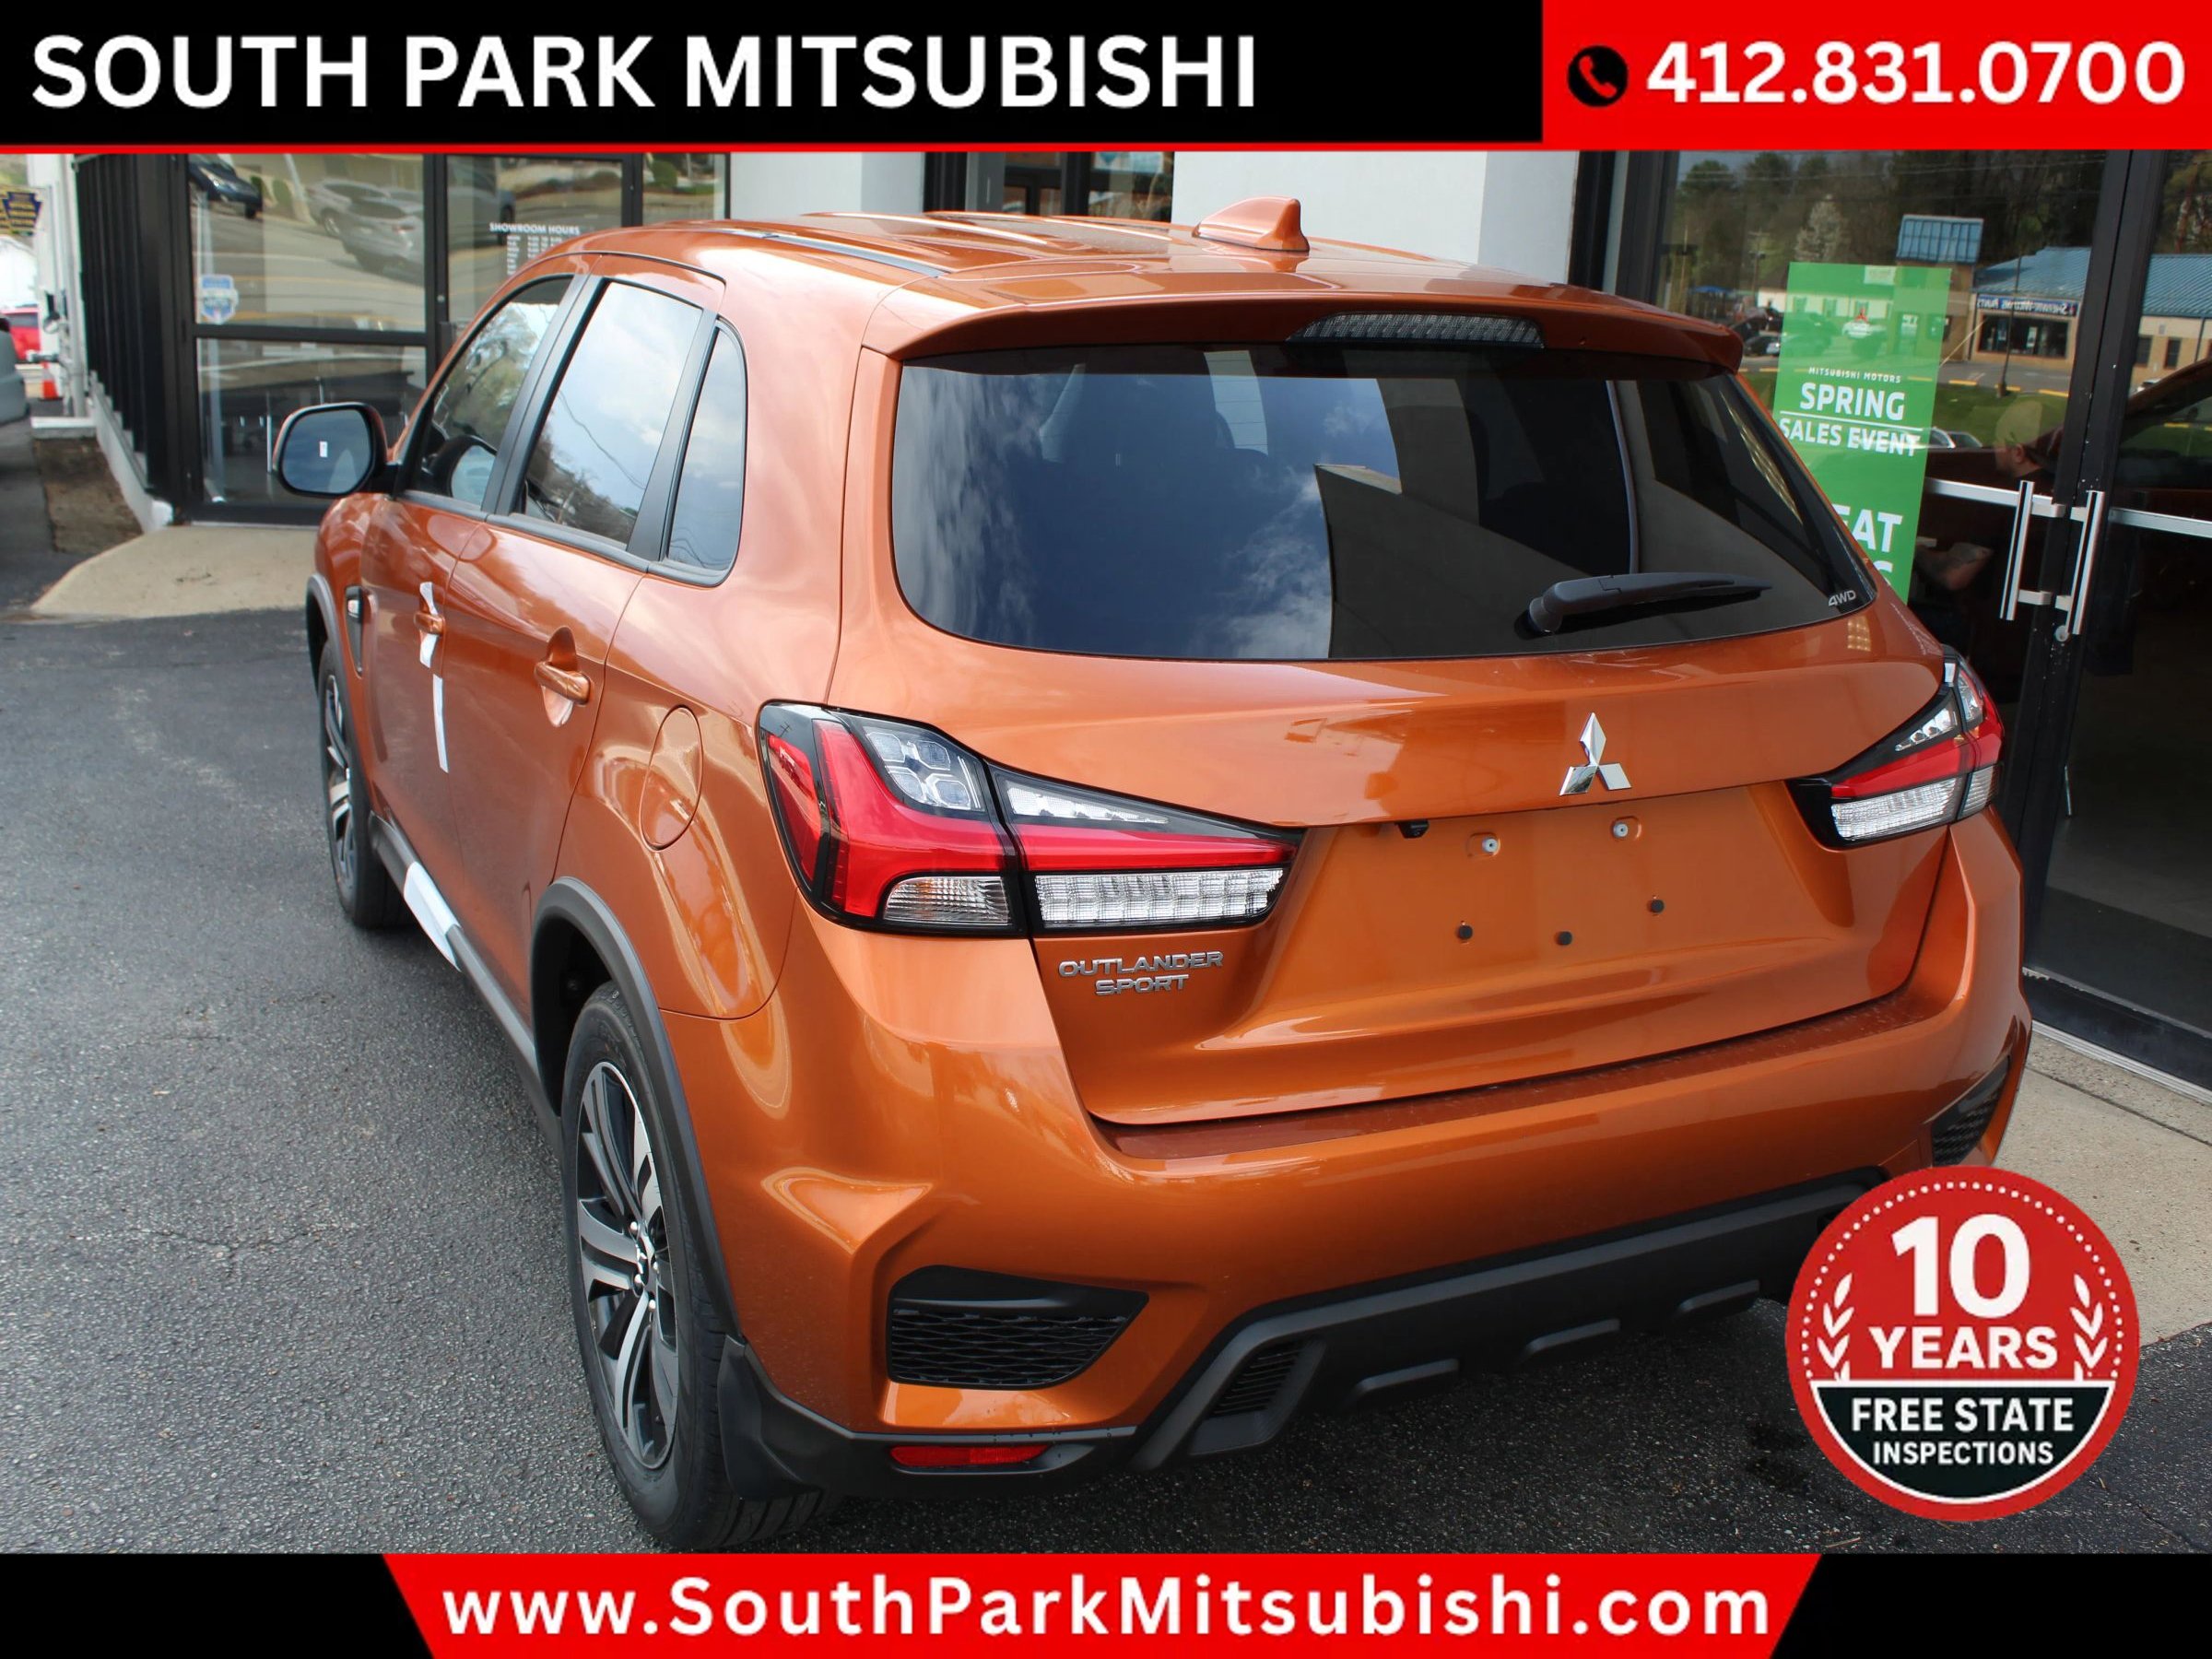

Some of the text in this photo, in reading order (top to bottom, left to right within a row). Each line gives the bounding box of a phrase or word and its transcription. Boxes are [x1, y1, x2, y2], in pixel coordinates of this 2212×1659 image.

[489, 222, 580, 235] SHOWROOM HOURS
[1808, 366, 1901, 383] MITSUBISHI MOTORS
[1800, 382, 1905, 421] SPRING
[1779, 418, 1922, 457] SALES EVENT
[1828, 590, 1857, 606] 4WD
[1058, 950, 1224, 978] OUTLANDER
[1094, 973, 1190, 996] SPORT
